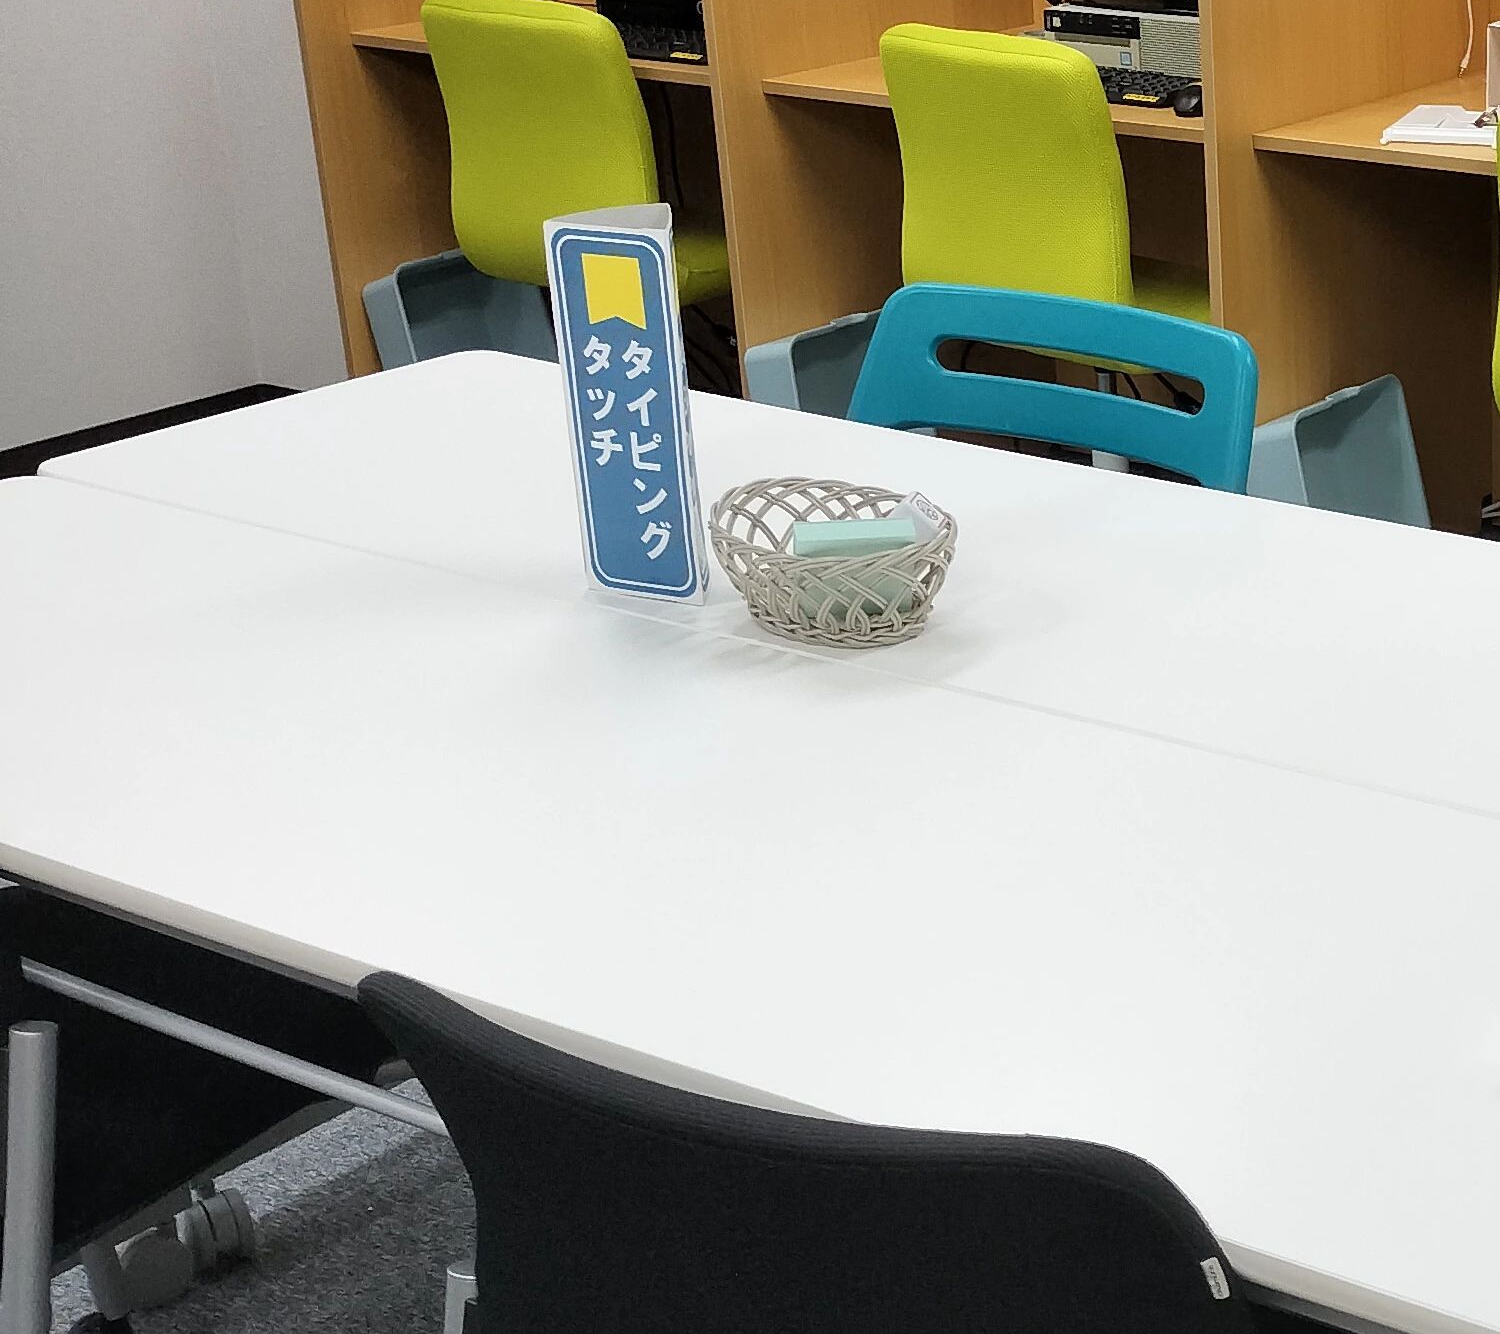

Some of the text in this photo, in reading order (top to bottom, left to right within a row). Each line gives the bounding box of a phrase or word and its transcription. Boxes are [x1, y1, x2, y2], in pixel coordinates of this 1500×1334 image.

[582, 335, 623, 466] タッチ
[622, 340, 673, 560] タイピング
